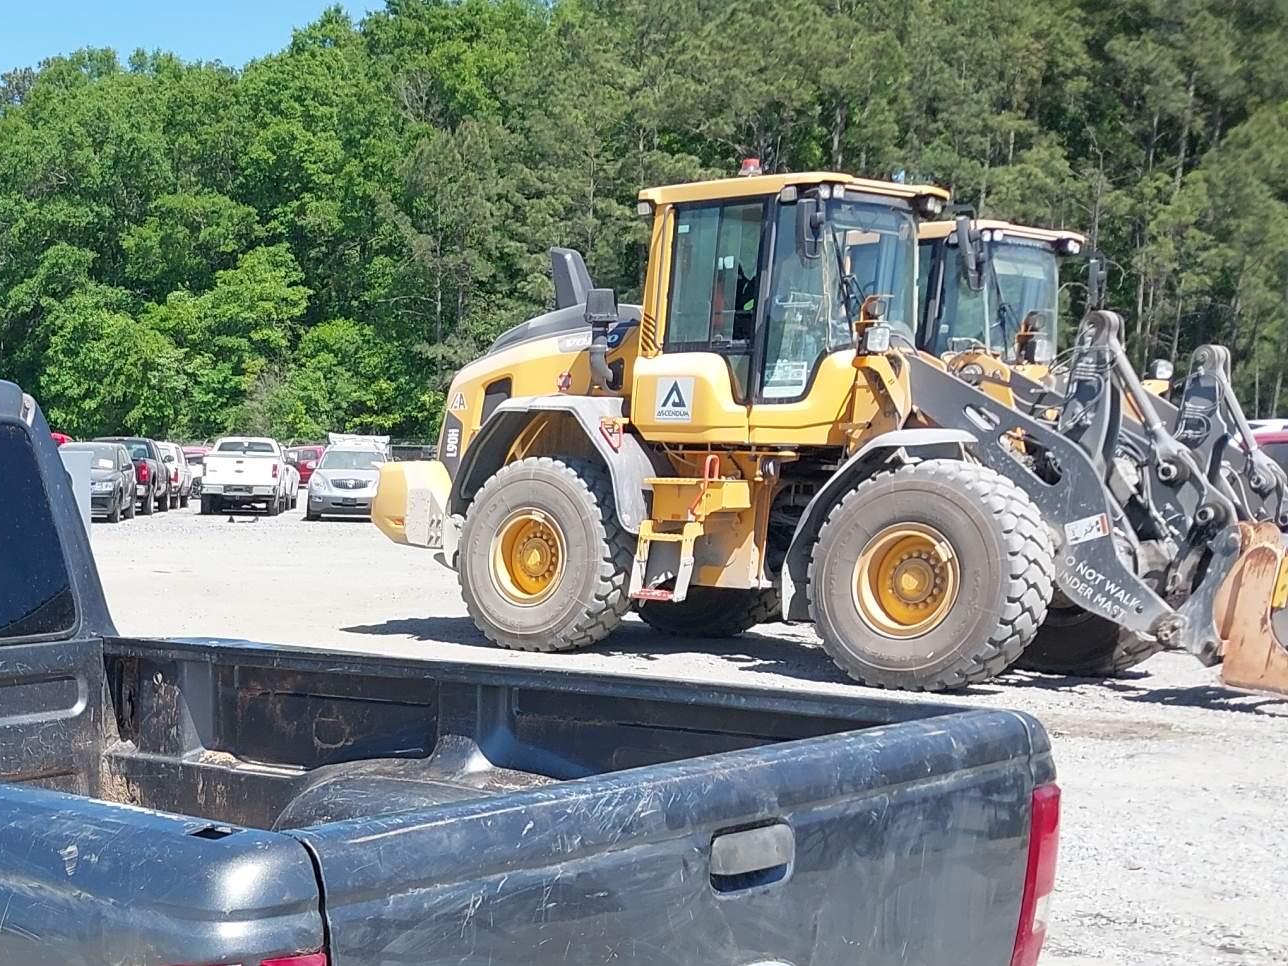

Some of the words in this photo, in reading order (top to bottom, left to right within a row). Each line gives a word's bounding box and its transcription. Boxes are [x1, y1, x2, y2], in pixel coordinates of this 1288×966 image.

[656, 409, 690, 417] ASCENDUM
[445, 428, 460, 458] L90H
[1075, 561, 1106, 586] NOT
[1104, 580, 1141, 608] WALK
[1094, 593, 1127, 619] MAST
